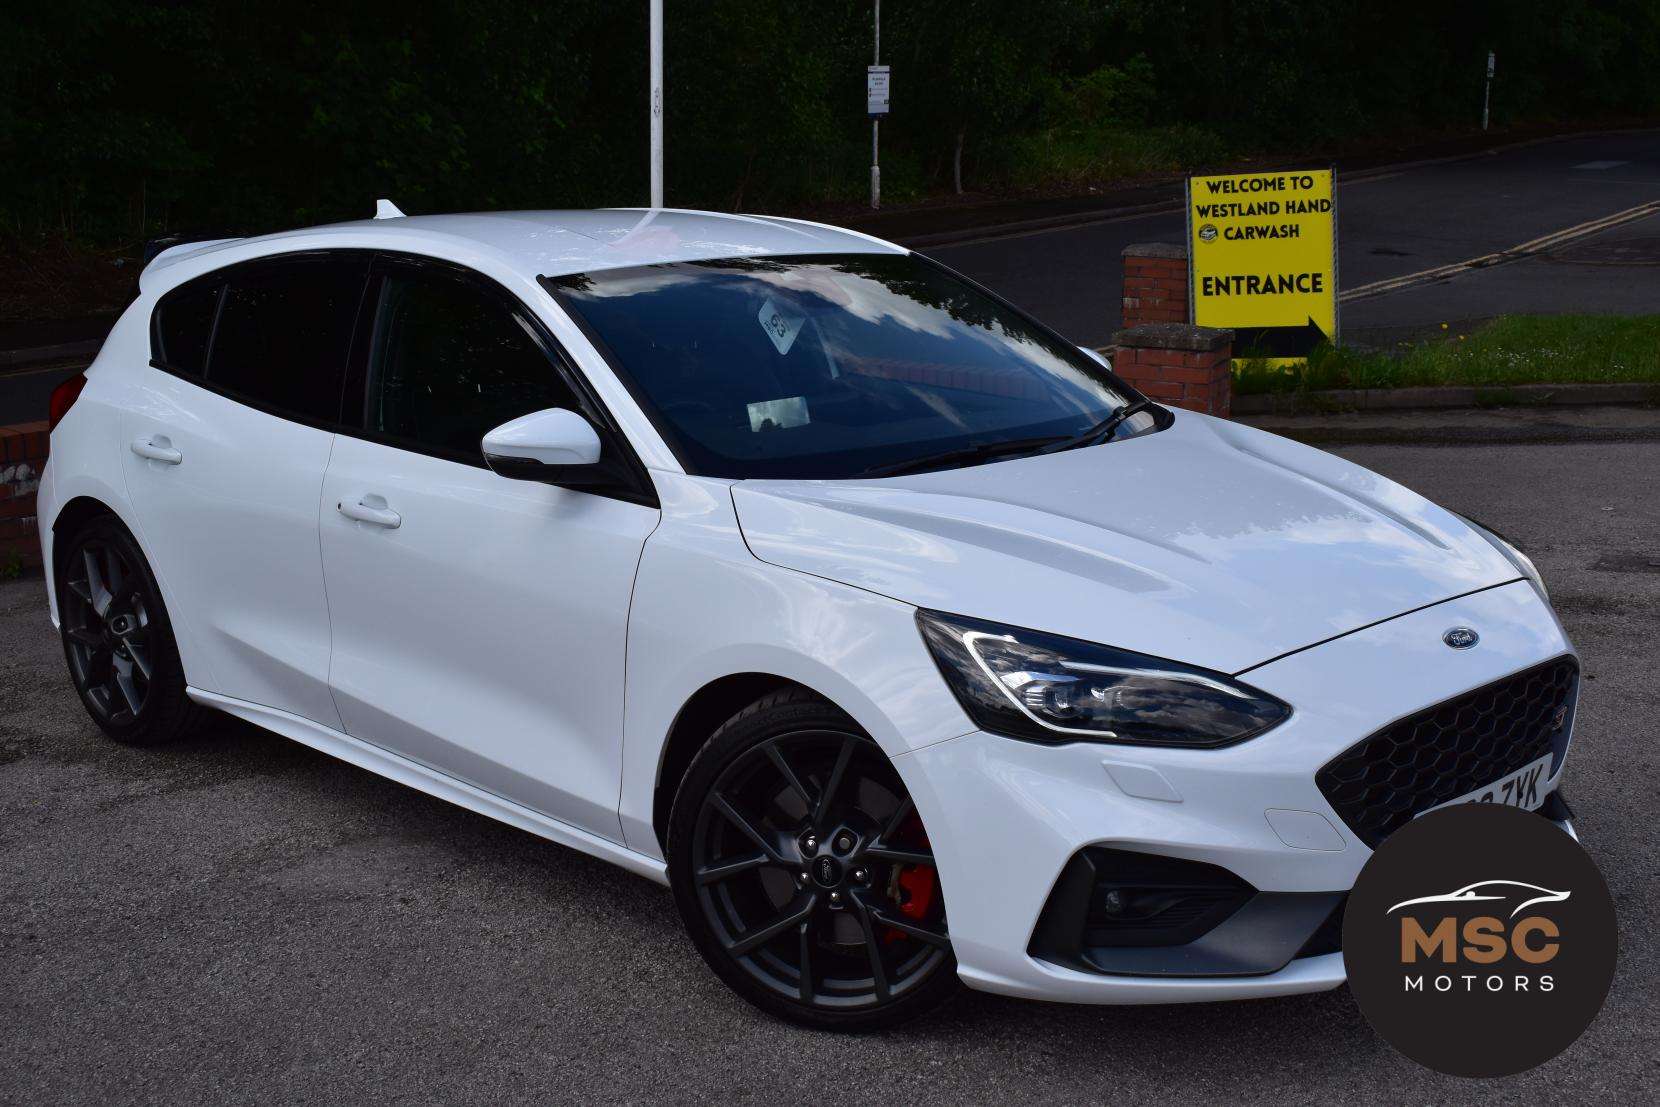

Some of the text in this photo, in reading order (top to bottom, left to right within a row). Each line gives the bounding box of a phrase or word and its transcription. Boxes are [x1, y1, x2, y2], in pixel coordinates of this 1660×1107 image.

[1206, 176, 1314, 194] WELCOME TO
[1196, 198, 1332, 219] WESTLAND HAND
[1223, 224, 1300, 240] CARWASH
[1202, 272, 1323, 297] ENTRANCE
[1502, 763, 1543, 808] ZYK
